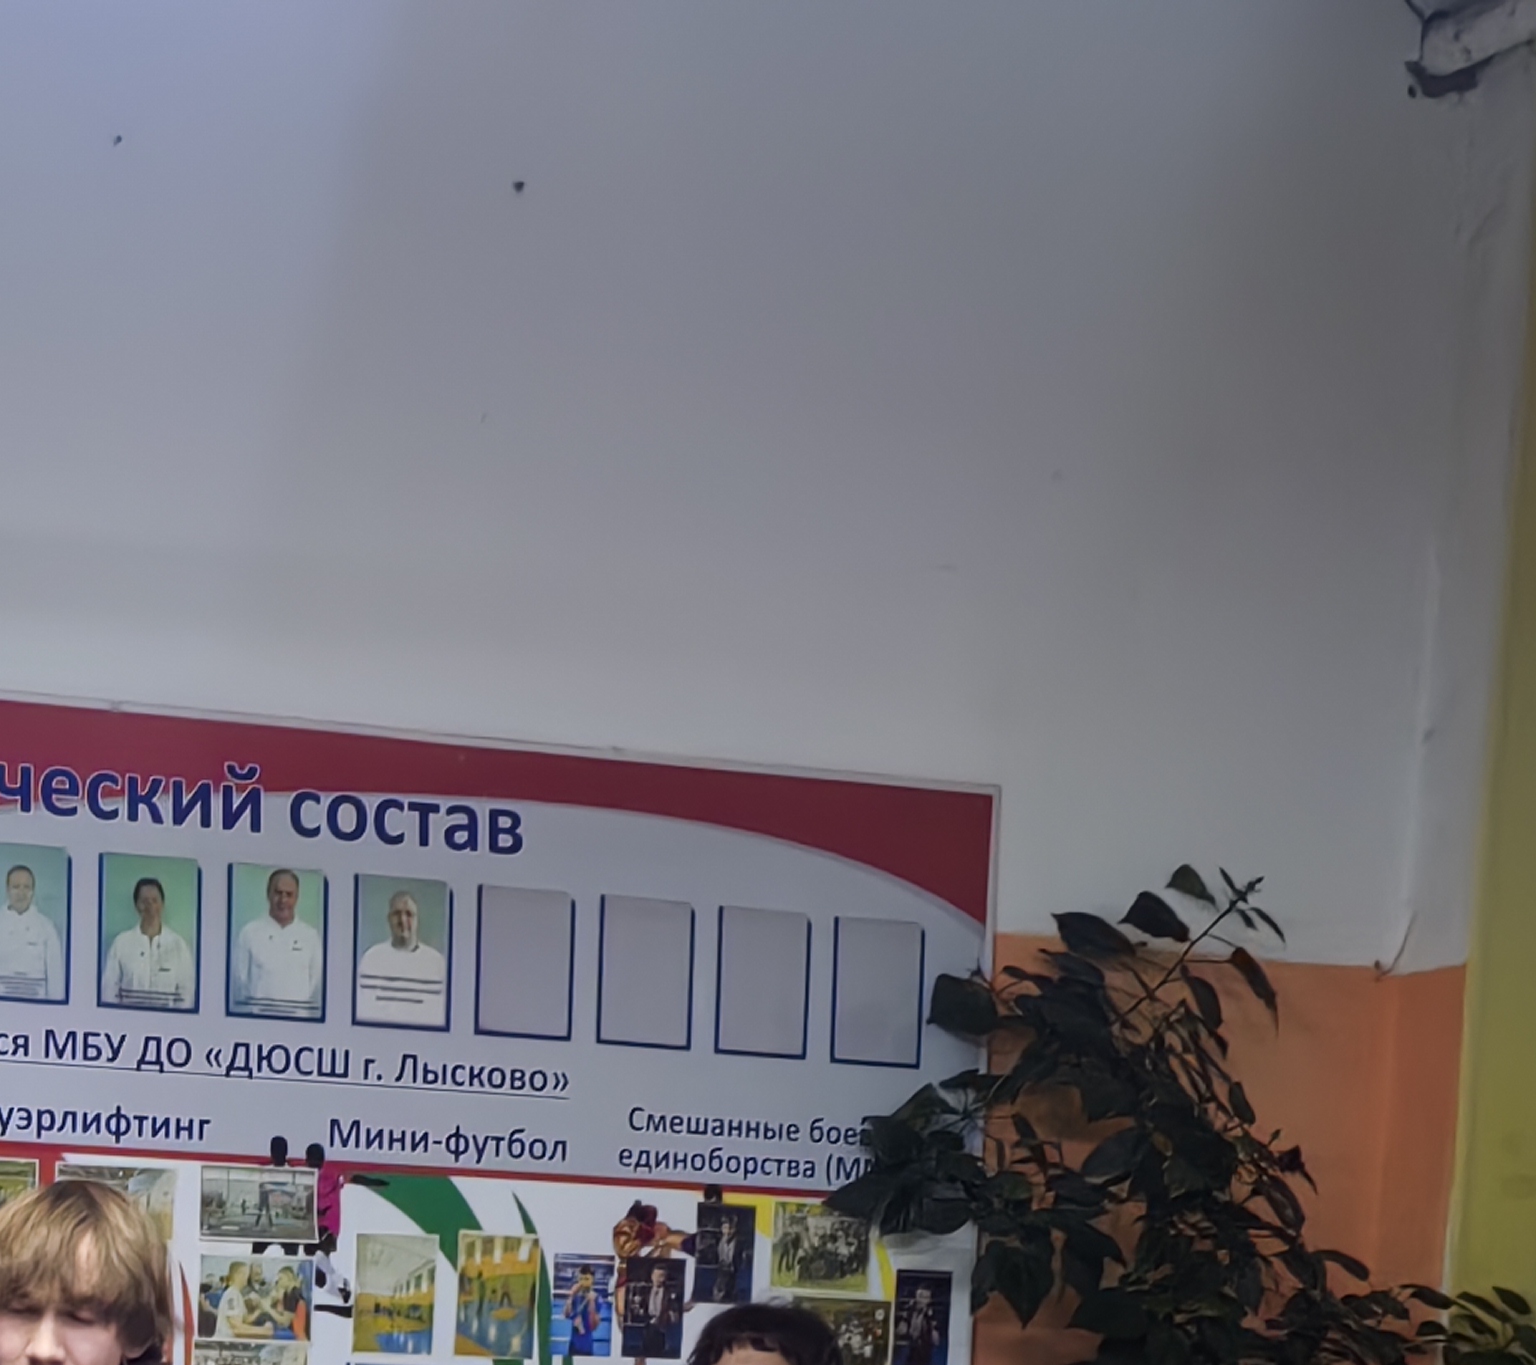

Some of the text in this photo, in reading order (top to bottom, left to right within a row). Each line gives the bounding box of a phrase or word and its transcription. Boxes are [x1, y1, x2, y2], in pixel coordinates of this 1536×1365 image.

[288, 788, 525, 856] состав
[43, 1029, 127, 1063] МБУ
[136, 1036, 193, 1072] ДО
[205, 1042, 350, 1079] «ДЮСШ
[363, 1057, 384, 1081] г.
[394, 1053, 571, 1093] Лысково»
[329, 1118, 568, 1164] Мини-футбол
[628, 1106, 800, 1143] Смешанные
[618, 1147, 816, 1179] единоборства
